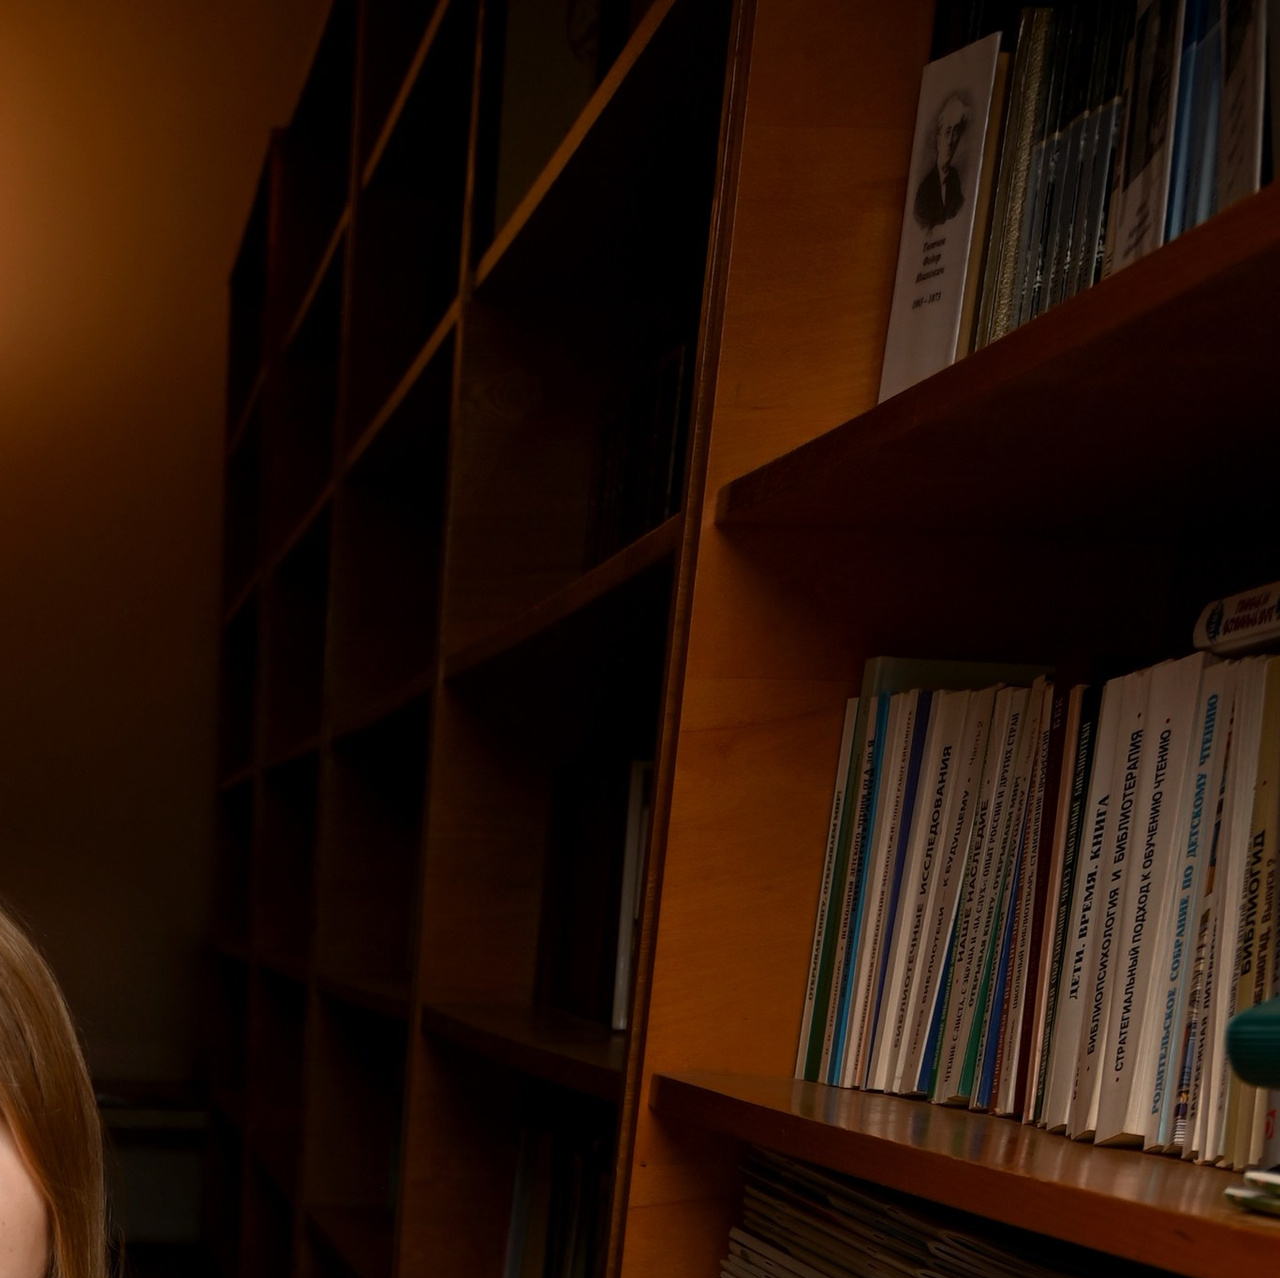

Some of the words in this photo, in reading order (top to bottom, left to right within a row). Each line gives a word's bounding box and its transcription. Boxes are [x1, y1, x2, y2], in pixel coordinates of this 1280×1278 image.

[1037, 730, 1050, 794] ПРОФЕССИИ
[1153, 727, 1171, 790] ЧТЕНИЮ
[1199, 693, 1218, 767] ЧТЕНИЮ
[1113, 726, 1142, 865] БИБЛИОТЕРАПИЯ
[1142, 789, 1162, 870] ОБУЧЕНИЮ
[1186, 773, 1208, 860] ДЕТСКОМУ
[892, 901, 924, 1049] БИБЛИОТЕЧНЫЕ
[918, 743, 953, 895] ИССЛЕДОВАНИЯ
[921, 905, 944, 1004] БИБЛИОТЕКИ
[944, 788, 970, 875] БУДУЩЕМУ
[956, 907, 971, 963] НАШЕ
[965, 799, 988, 903] НАСЛЕДИЕ
[1068, 942, 1085, 1002] ДЕТИ.
[1077, 863, 1098, 940] ВРЕМЯ.
[1089, 792, 1110, 862] КНИГА
[1110, 866, 1121, 883] И
[1132, 880, 1150, 945] ПОДХОД
[1139, 869, 1150, 883] К
[1182, 864, 1194, 891] ПО
[1238, 826, 1265, 978] БИБЛИОГИД
[1086, 886, 1117, 1057] БИБЛИОПСИХОЛОГИЯ
[1168, 895, 1188, 982] СОБРАНИЕ
[1113, 944, 1139, 1073] СТРАТЕГИАЛЬНЫЙ
[1151, 987, 1176, 1115] РОДИТЕЛЬСКОЕ
[1189, 1014, 1207, 1118] ЗАРУБЕЖНАЯ
